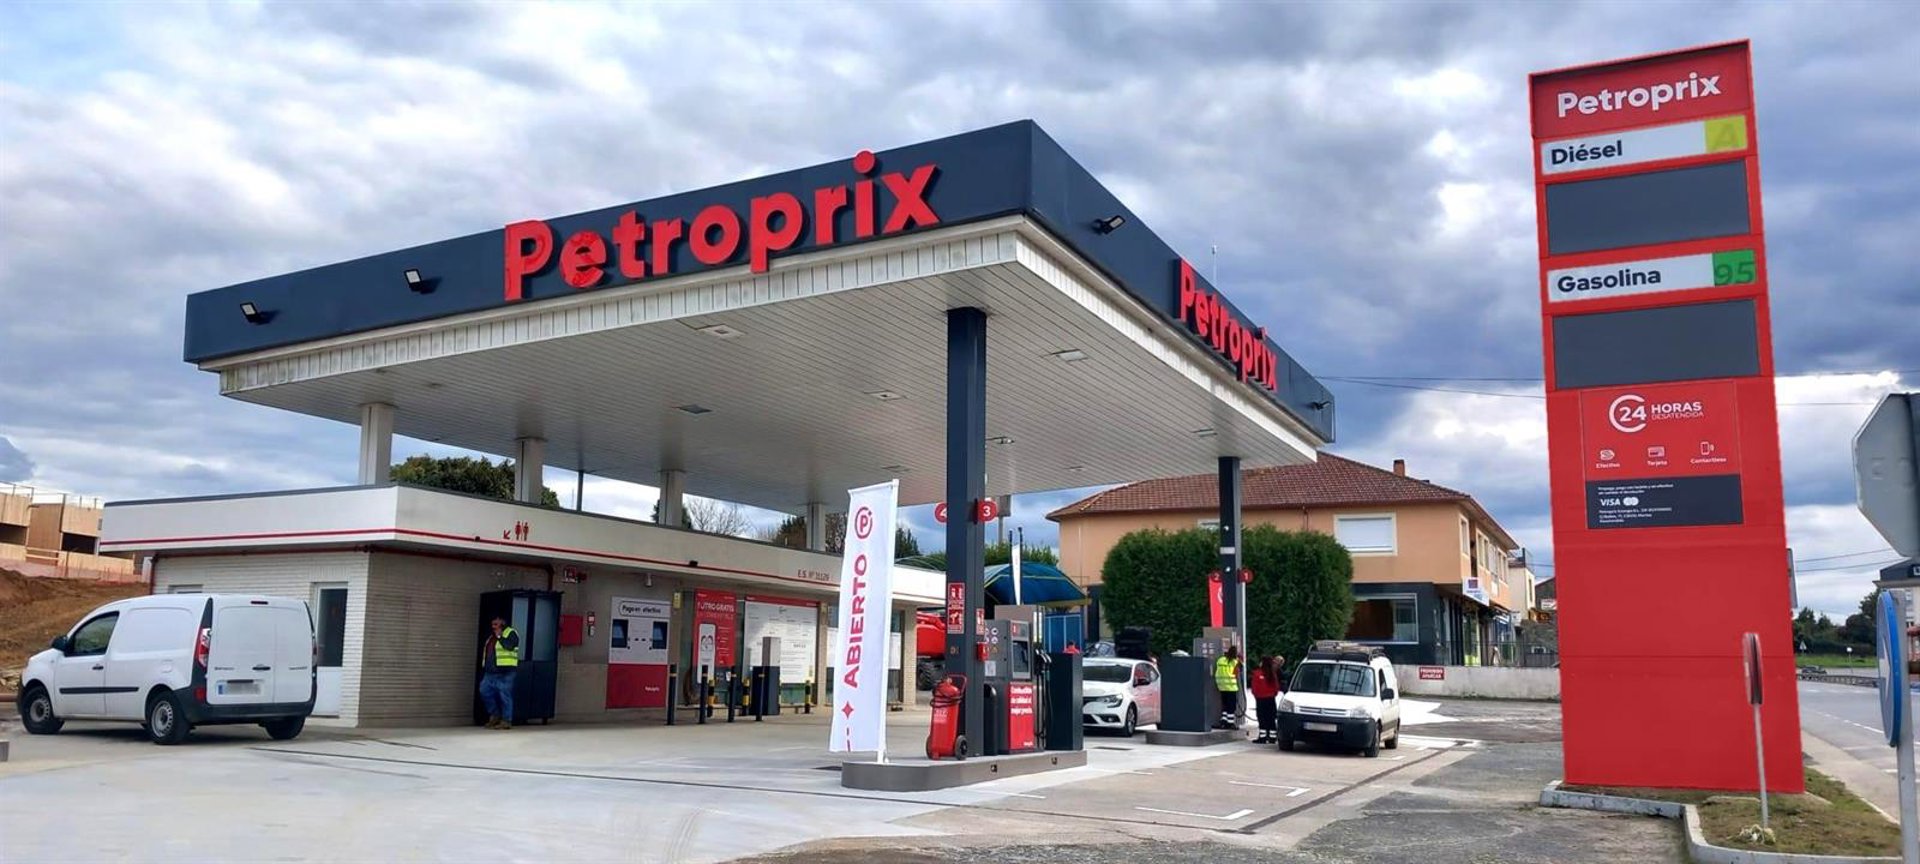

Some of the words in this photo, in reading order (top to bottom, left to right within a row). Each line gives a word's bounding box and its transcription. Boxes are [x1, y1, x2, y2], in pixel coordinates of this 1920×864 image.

[1557, 72, 1721, 117] Petroprix
[1551, 140, 1623, 165] Diésel
[504, 150, 940, 301] Petroprix
[1557, 267, 1661, 293] Gasolina
[1714, 261, 1756, 286] 95
[1179, 257, 1278, 393] Petroprix
[1619, 405, 1647, 422] 24
[1651, 401, 1702, 414] HORAS
[1651, 411, 1704, 420] DESATENDIDA
[983, 505, 991, 517] 3
[1600, 498, 1621, 506] VISA
[1213, 572, 1220, 581] 2
[844, 553, 868, 689] ABIERTO
